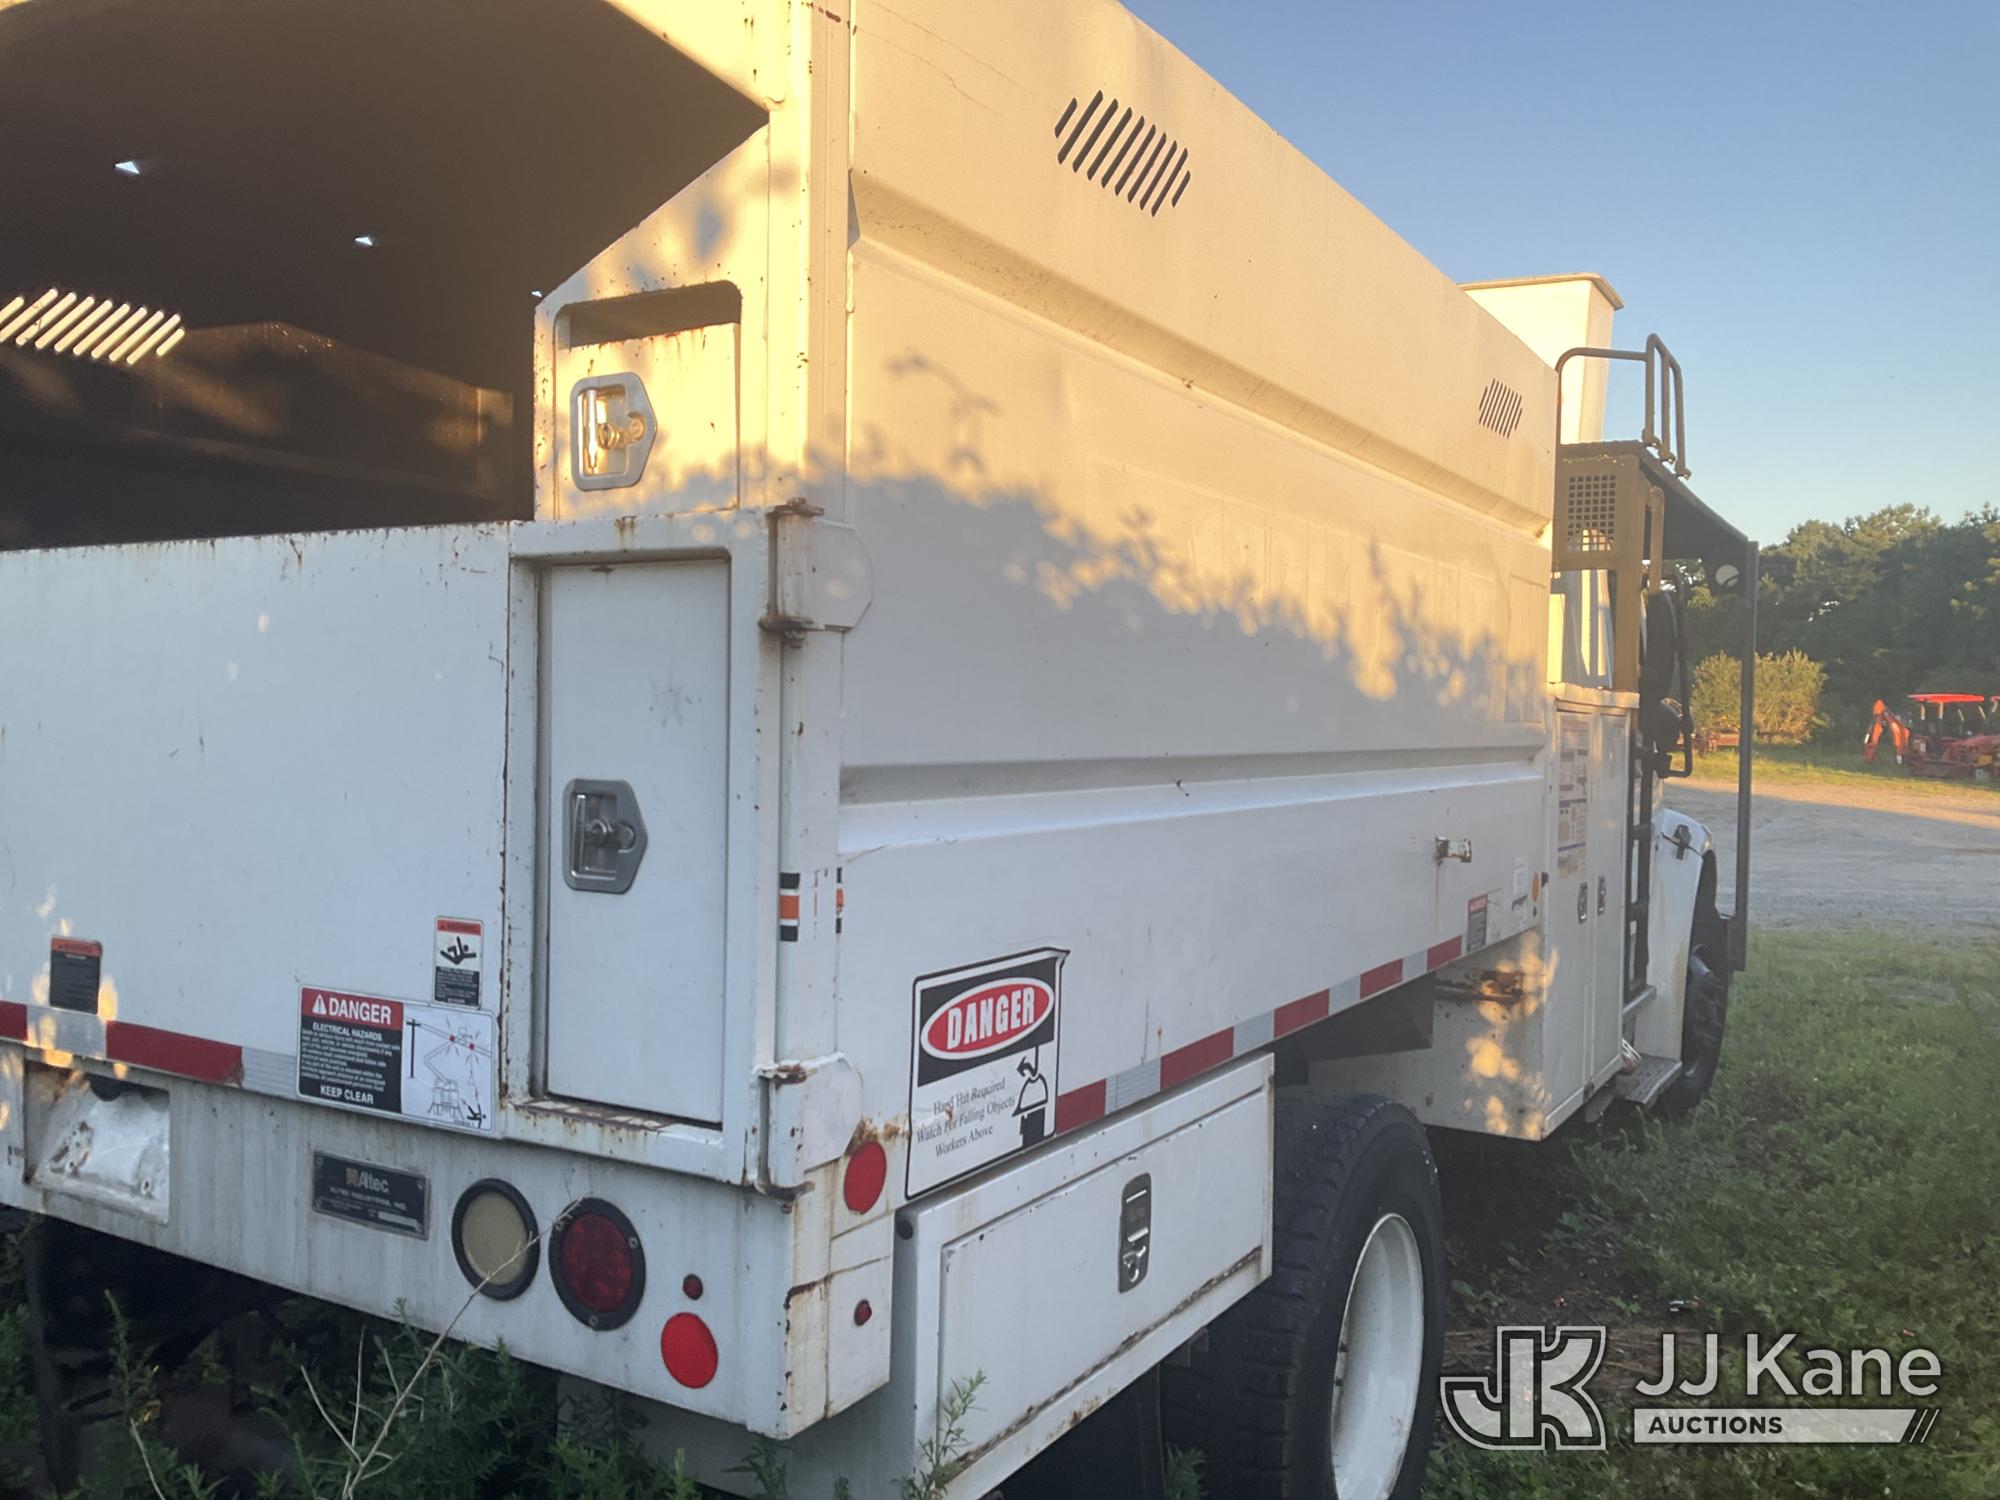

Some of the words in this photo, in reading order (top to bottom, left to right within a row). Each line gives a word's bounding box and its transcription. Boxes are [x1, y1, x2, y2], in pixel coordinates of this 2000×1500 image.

[328, 997, 392, 1026] DANGER
[947, 987, 1035, 1050] DANGER
[312, 1022, 350, 1037] ELECTRICAL
[351, 1029, 383, 1042] HAZARDS
[320, 1084, 343, 1098] KEEP
[344, 1089, 374, 1105] CLEAR
[933, 1095, 954, 1115] Hard
[955, 1093, 970, 1108] Hat
[970, 1077, 1006, 1100] Required
[916, 1123, 942, 1143] Watch
[958, 1108, 985, 1127] Falling
[986, 1096, 1016, 1114] Objects
[935, 1136, 967, 1157] Workers
[968, 1125, 994, 1143] Above
[358, 1171, 389, 1194] Altec
